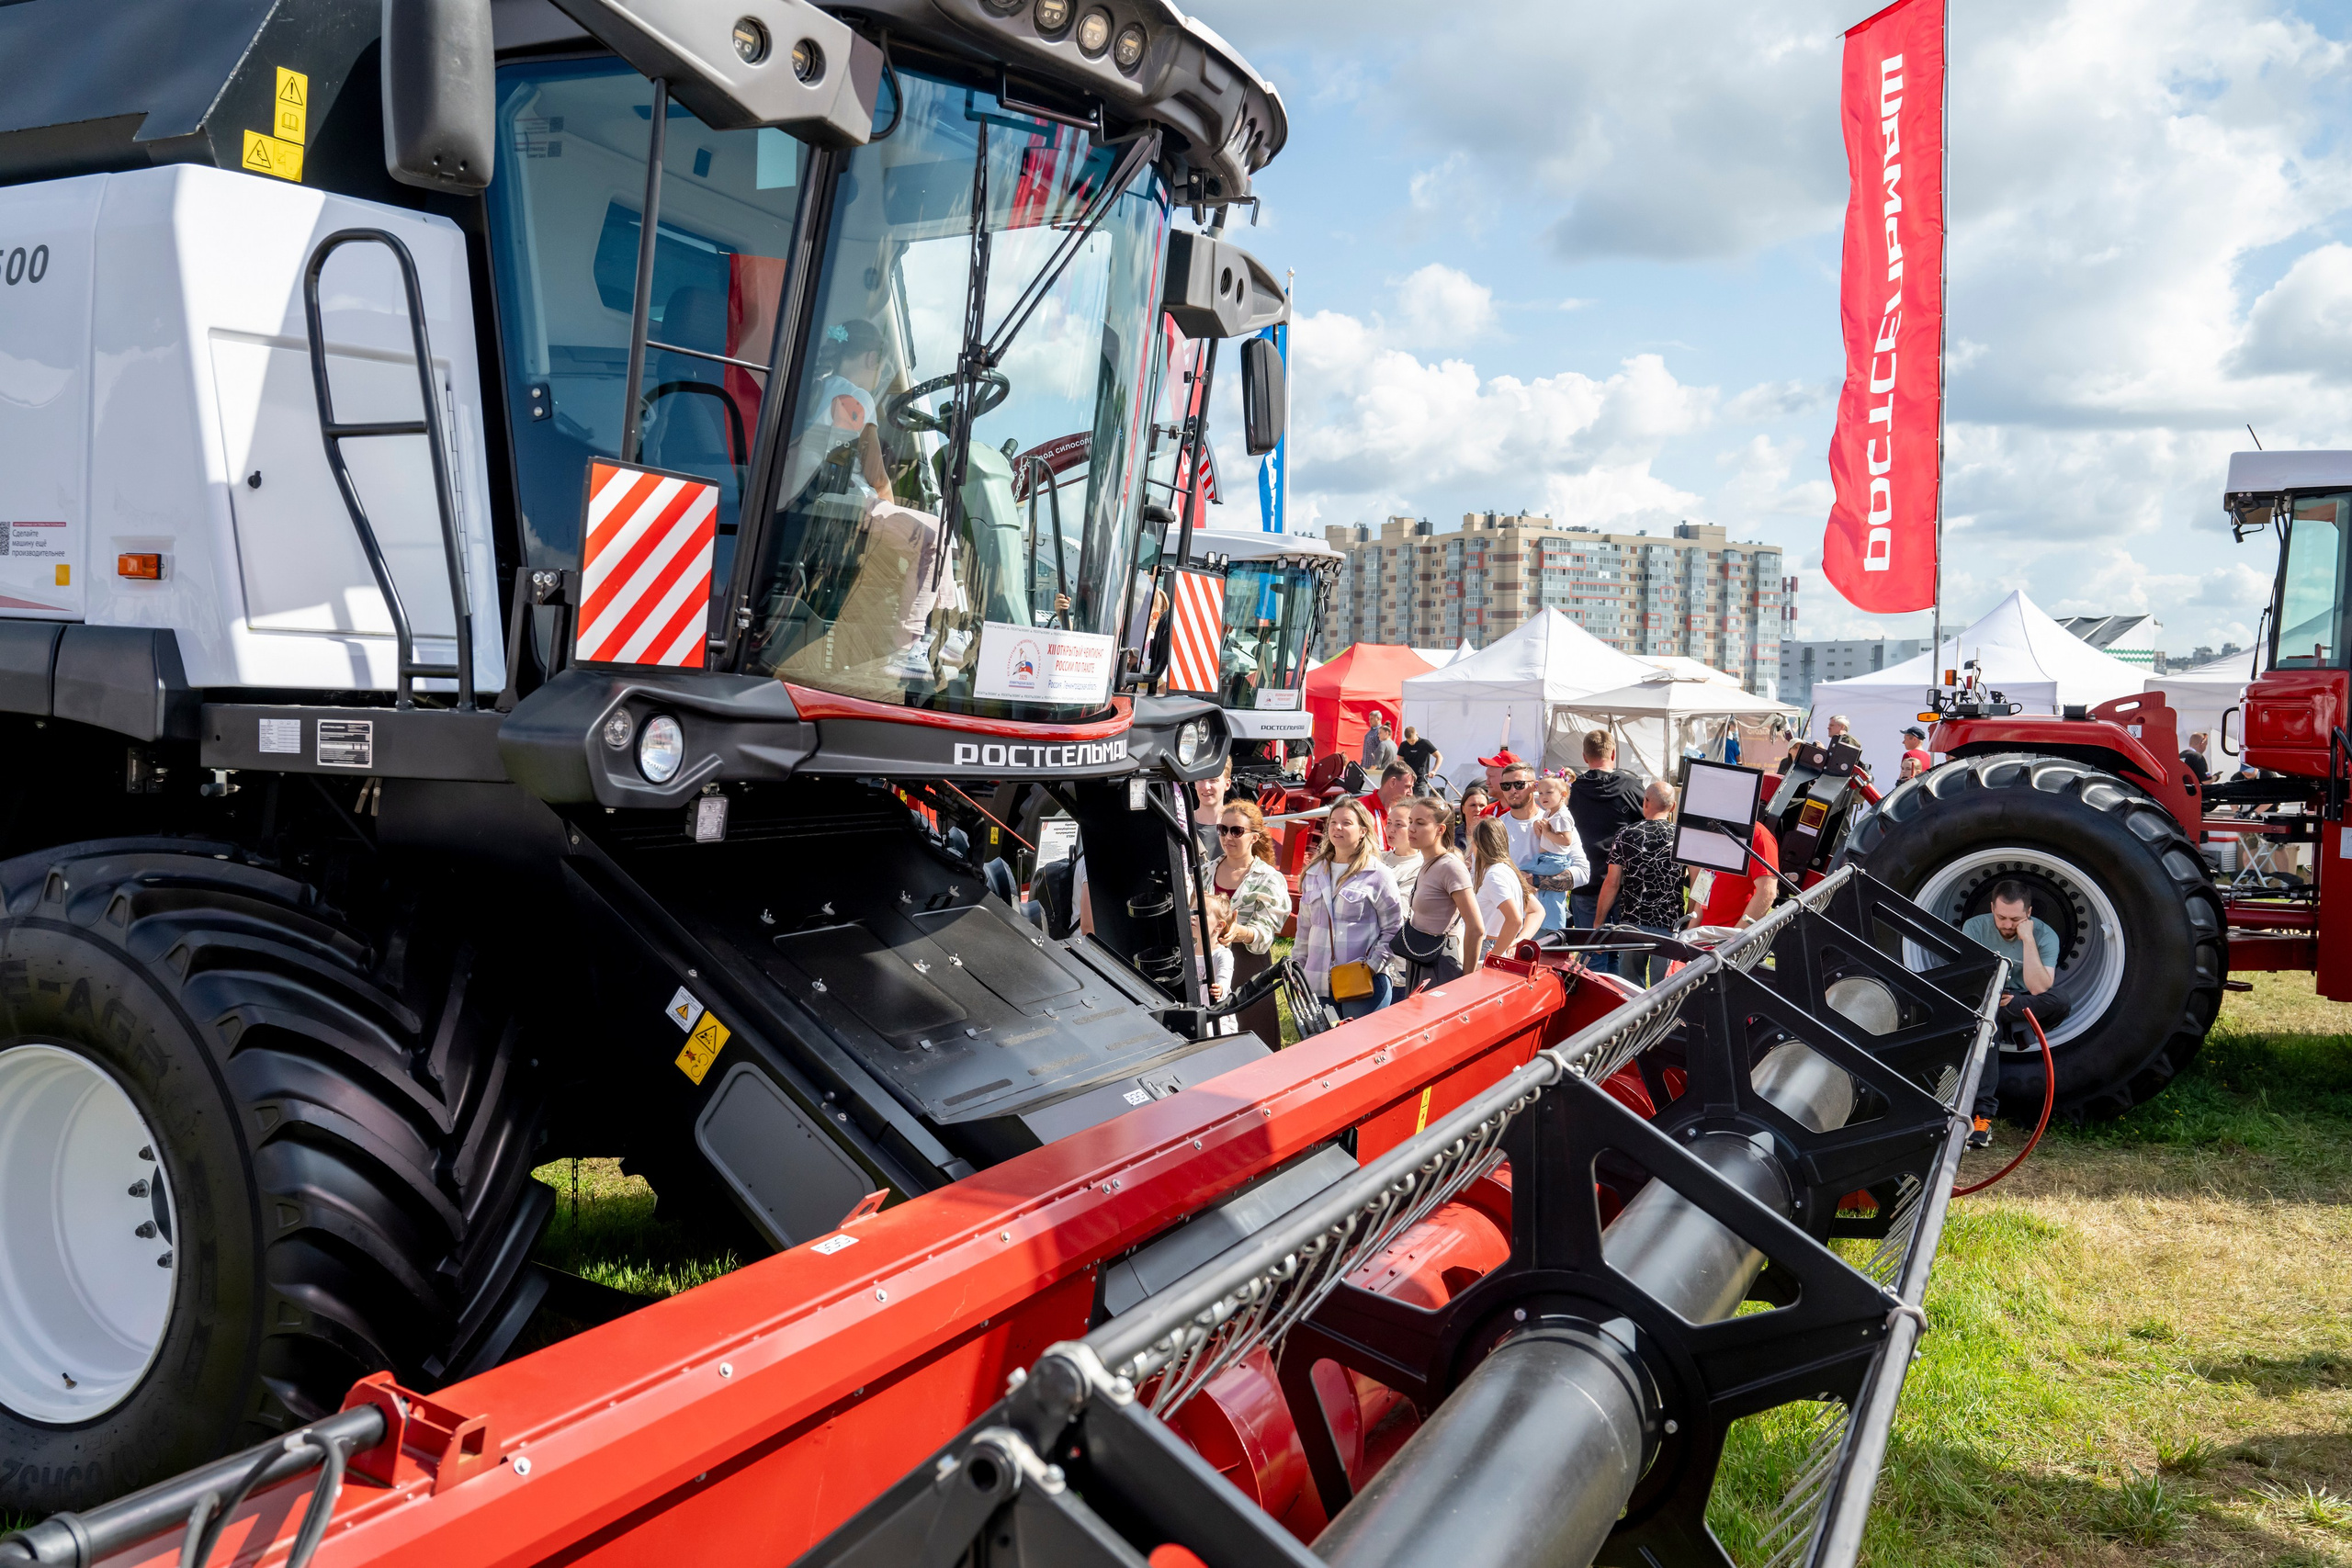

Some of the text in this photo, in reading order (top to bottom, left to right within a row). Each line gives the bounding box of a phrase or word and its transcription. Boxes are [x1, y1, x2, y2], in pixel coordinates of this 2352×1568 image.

[0, 244, 50, 286] 00
[12, 529, 39, 537] Сделайте
[12, 538, 47, 548] машину ещё
[954, 739, 1127, 767] РОСТСЕЛЬМАШ
